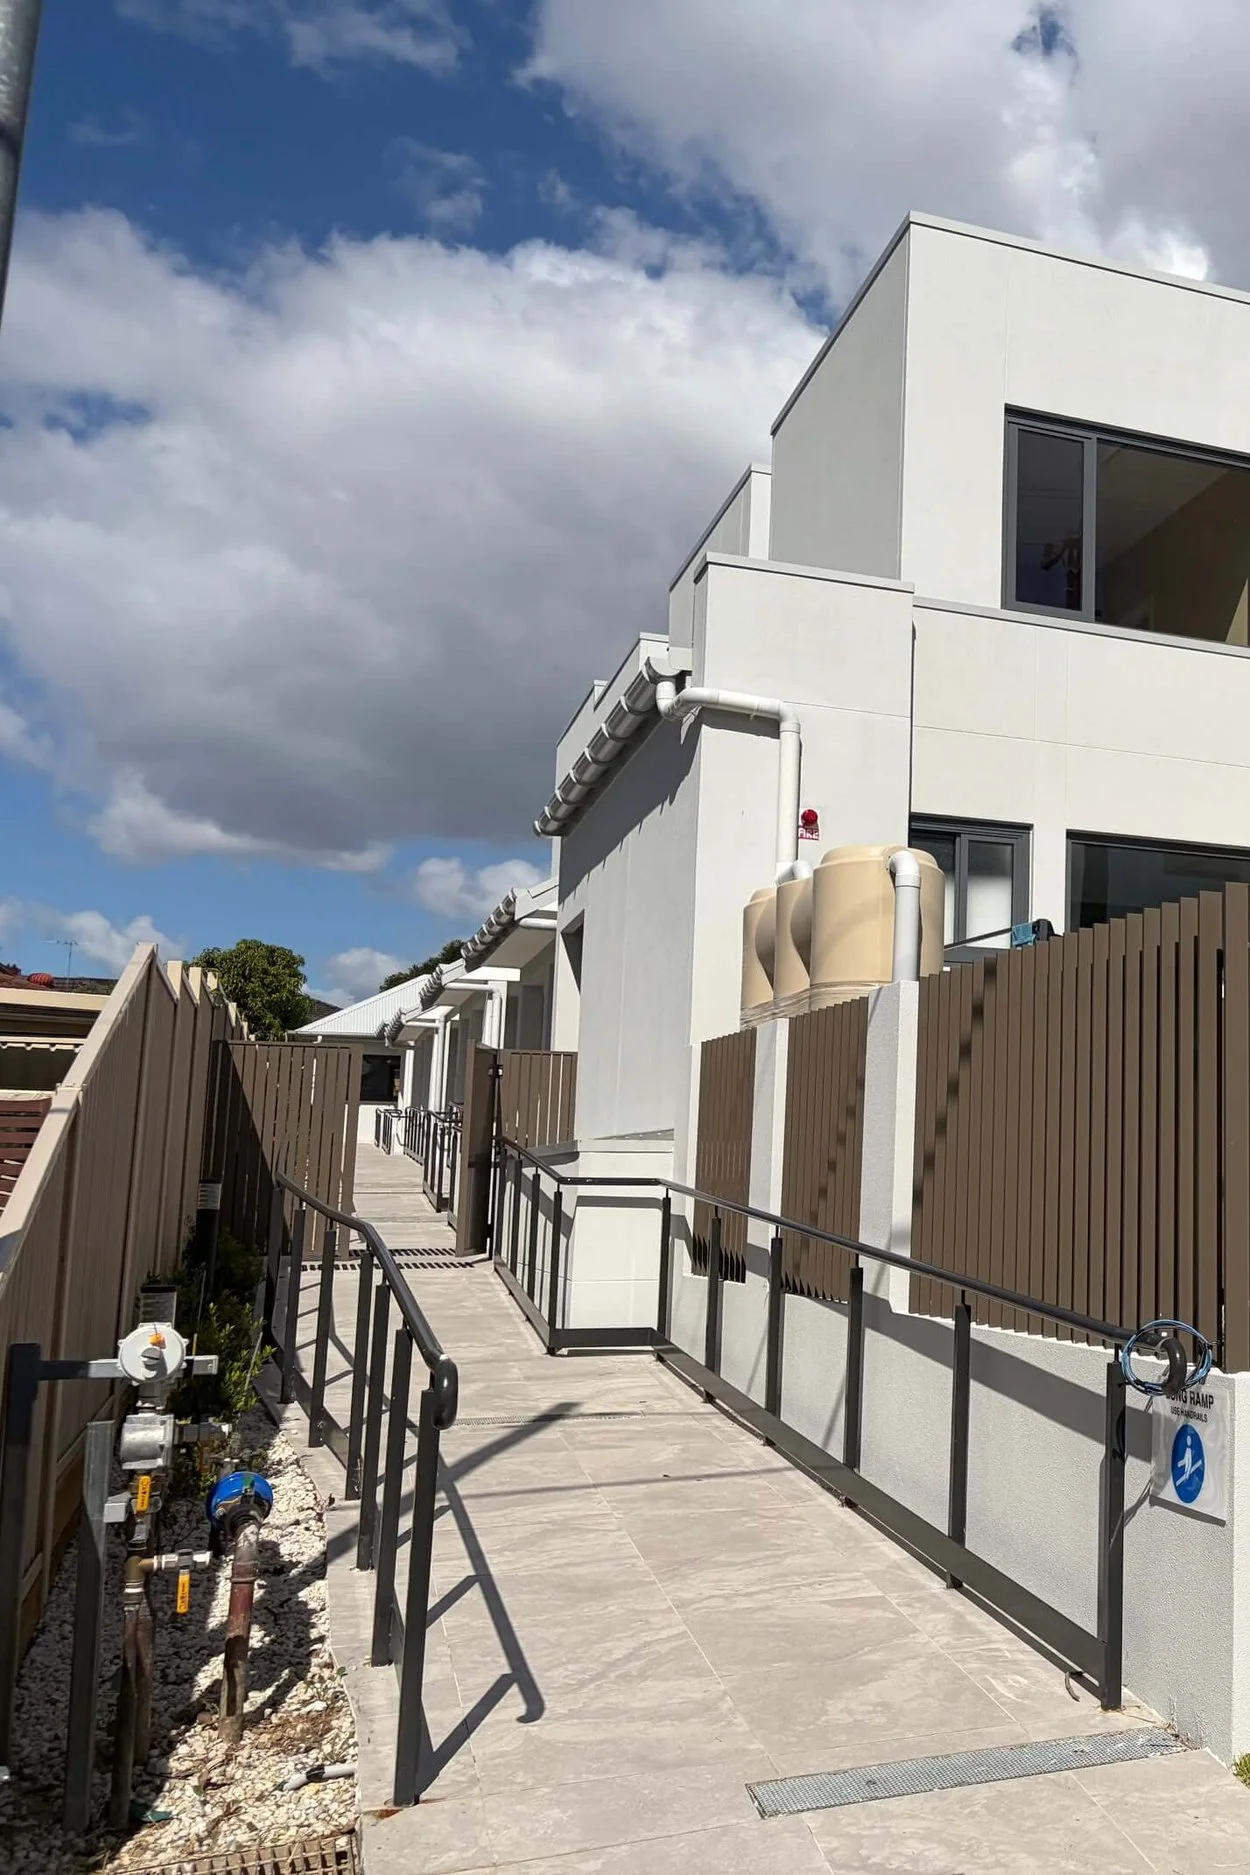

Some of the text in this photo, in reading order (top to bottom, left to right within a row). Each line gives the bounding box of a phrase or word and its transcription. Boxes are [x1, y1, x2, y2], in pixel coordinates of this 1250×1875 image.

[1166, 1389, 1214, 1409] NG RAMP
[1171, 1406, 1207, 1422] USE HANDRAILS
